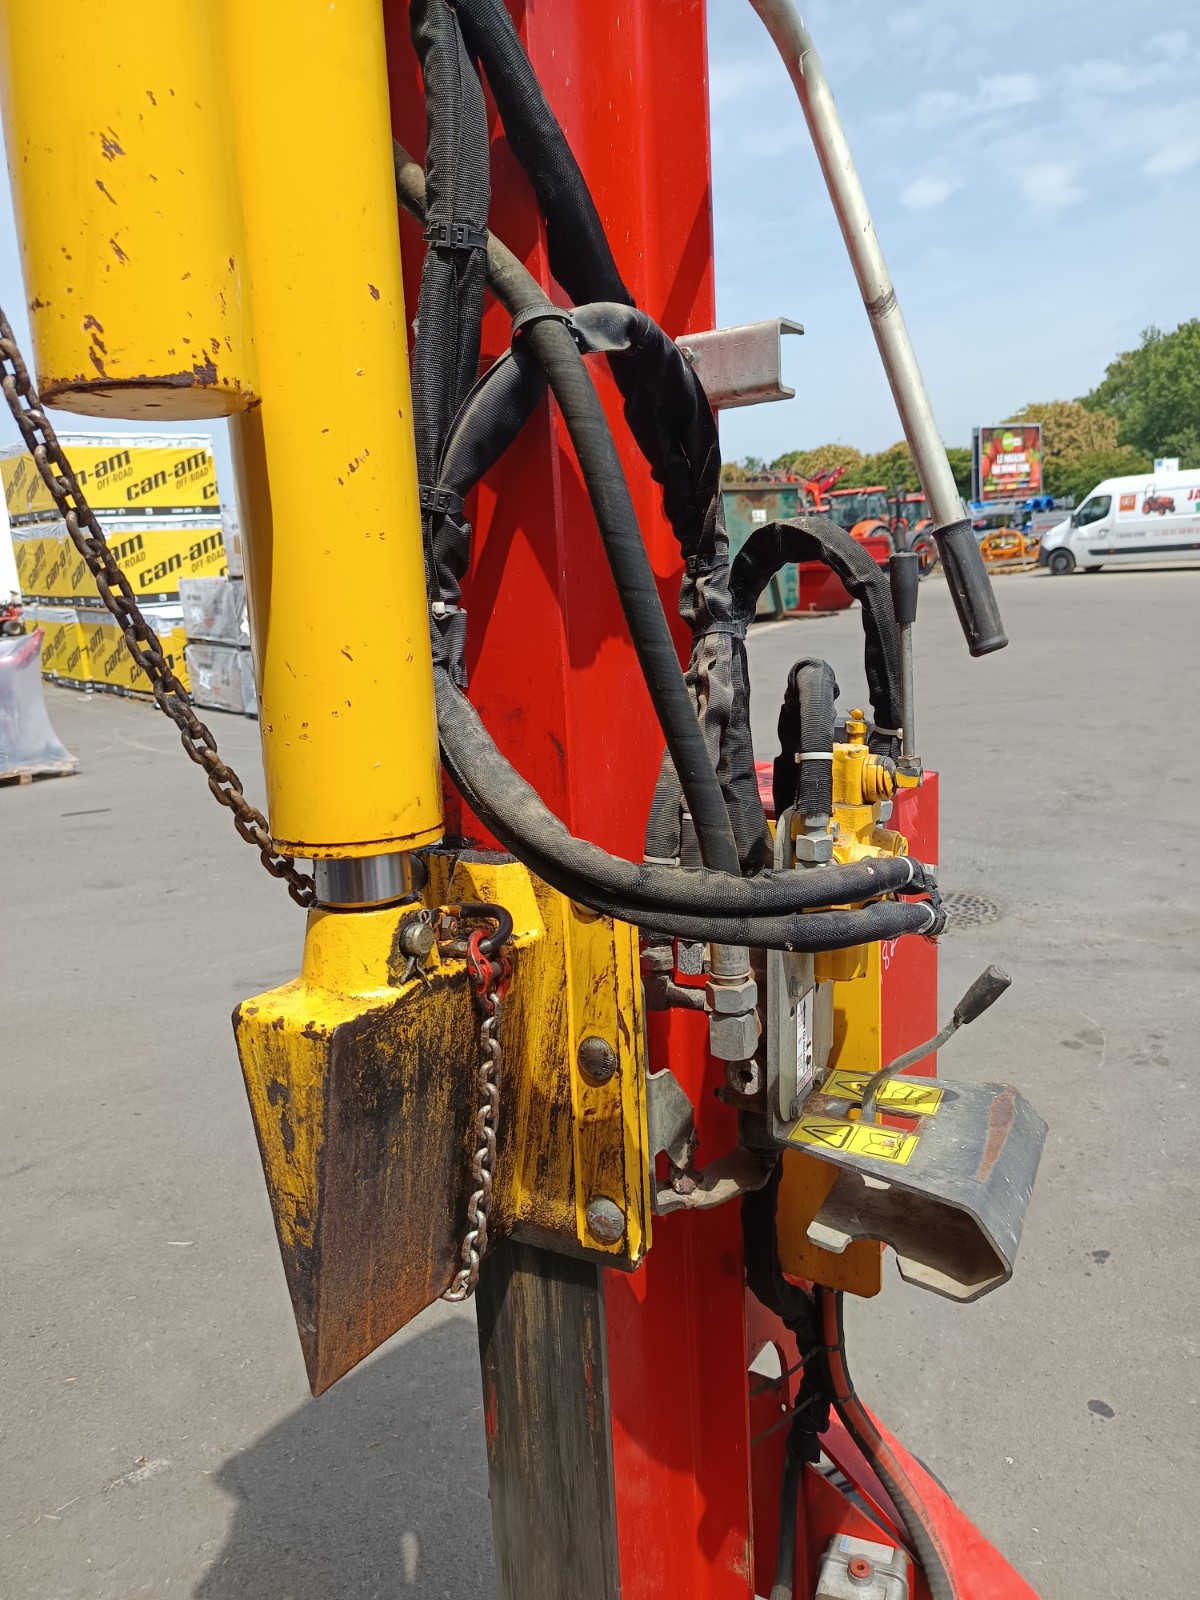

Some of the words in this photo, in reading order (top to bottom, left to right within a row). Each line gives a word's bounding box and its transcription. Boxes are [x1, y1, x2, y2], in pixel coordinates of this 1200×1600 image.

[75, 450, 131, 487] n-am
[97, 467, 134, 490] OFF-ROAD
[126, 451, 207, 501] can-am
[176, 467, 209, 490] OFF-ROAD
[139, 532, 224, 588] can-am
[191, 547, 226, 573] OFF-ROAD
